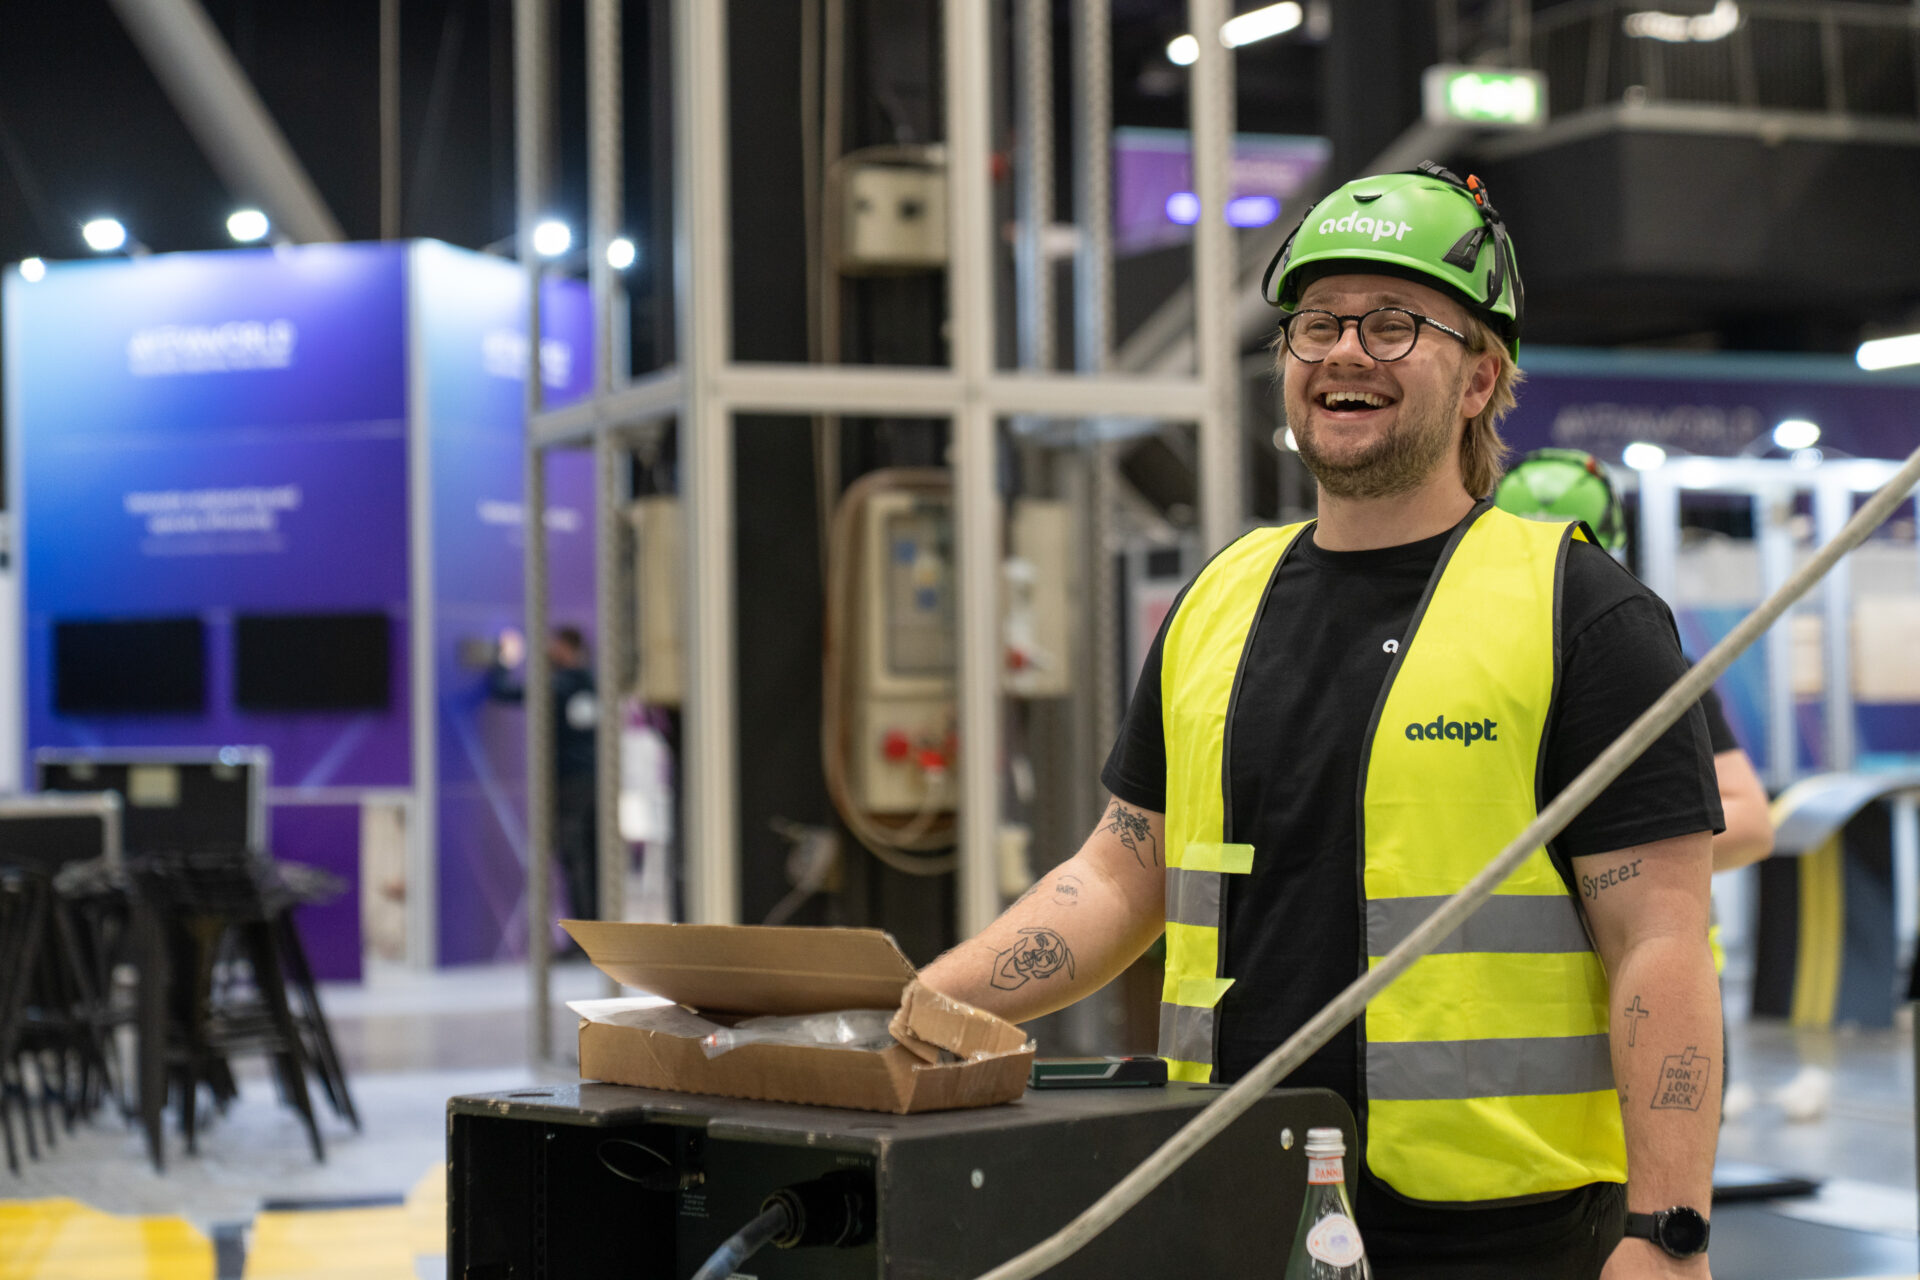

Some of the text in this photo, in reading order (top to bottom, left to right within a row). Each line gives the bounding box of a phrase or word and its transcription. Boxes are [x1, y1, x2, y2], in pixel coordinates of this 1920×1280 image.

[1319, 210, 1413, 242] adapt
[1405, 715, 1497, 747] adapt
[1582, 859, 1642, 900] Syster
[1666, 1068, 1702, 1081] DON'T
[1667, 1081, 1698, 1094] LOOK
[1661, 1093, 1692, 1105] BACK
